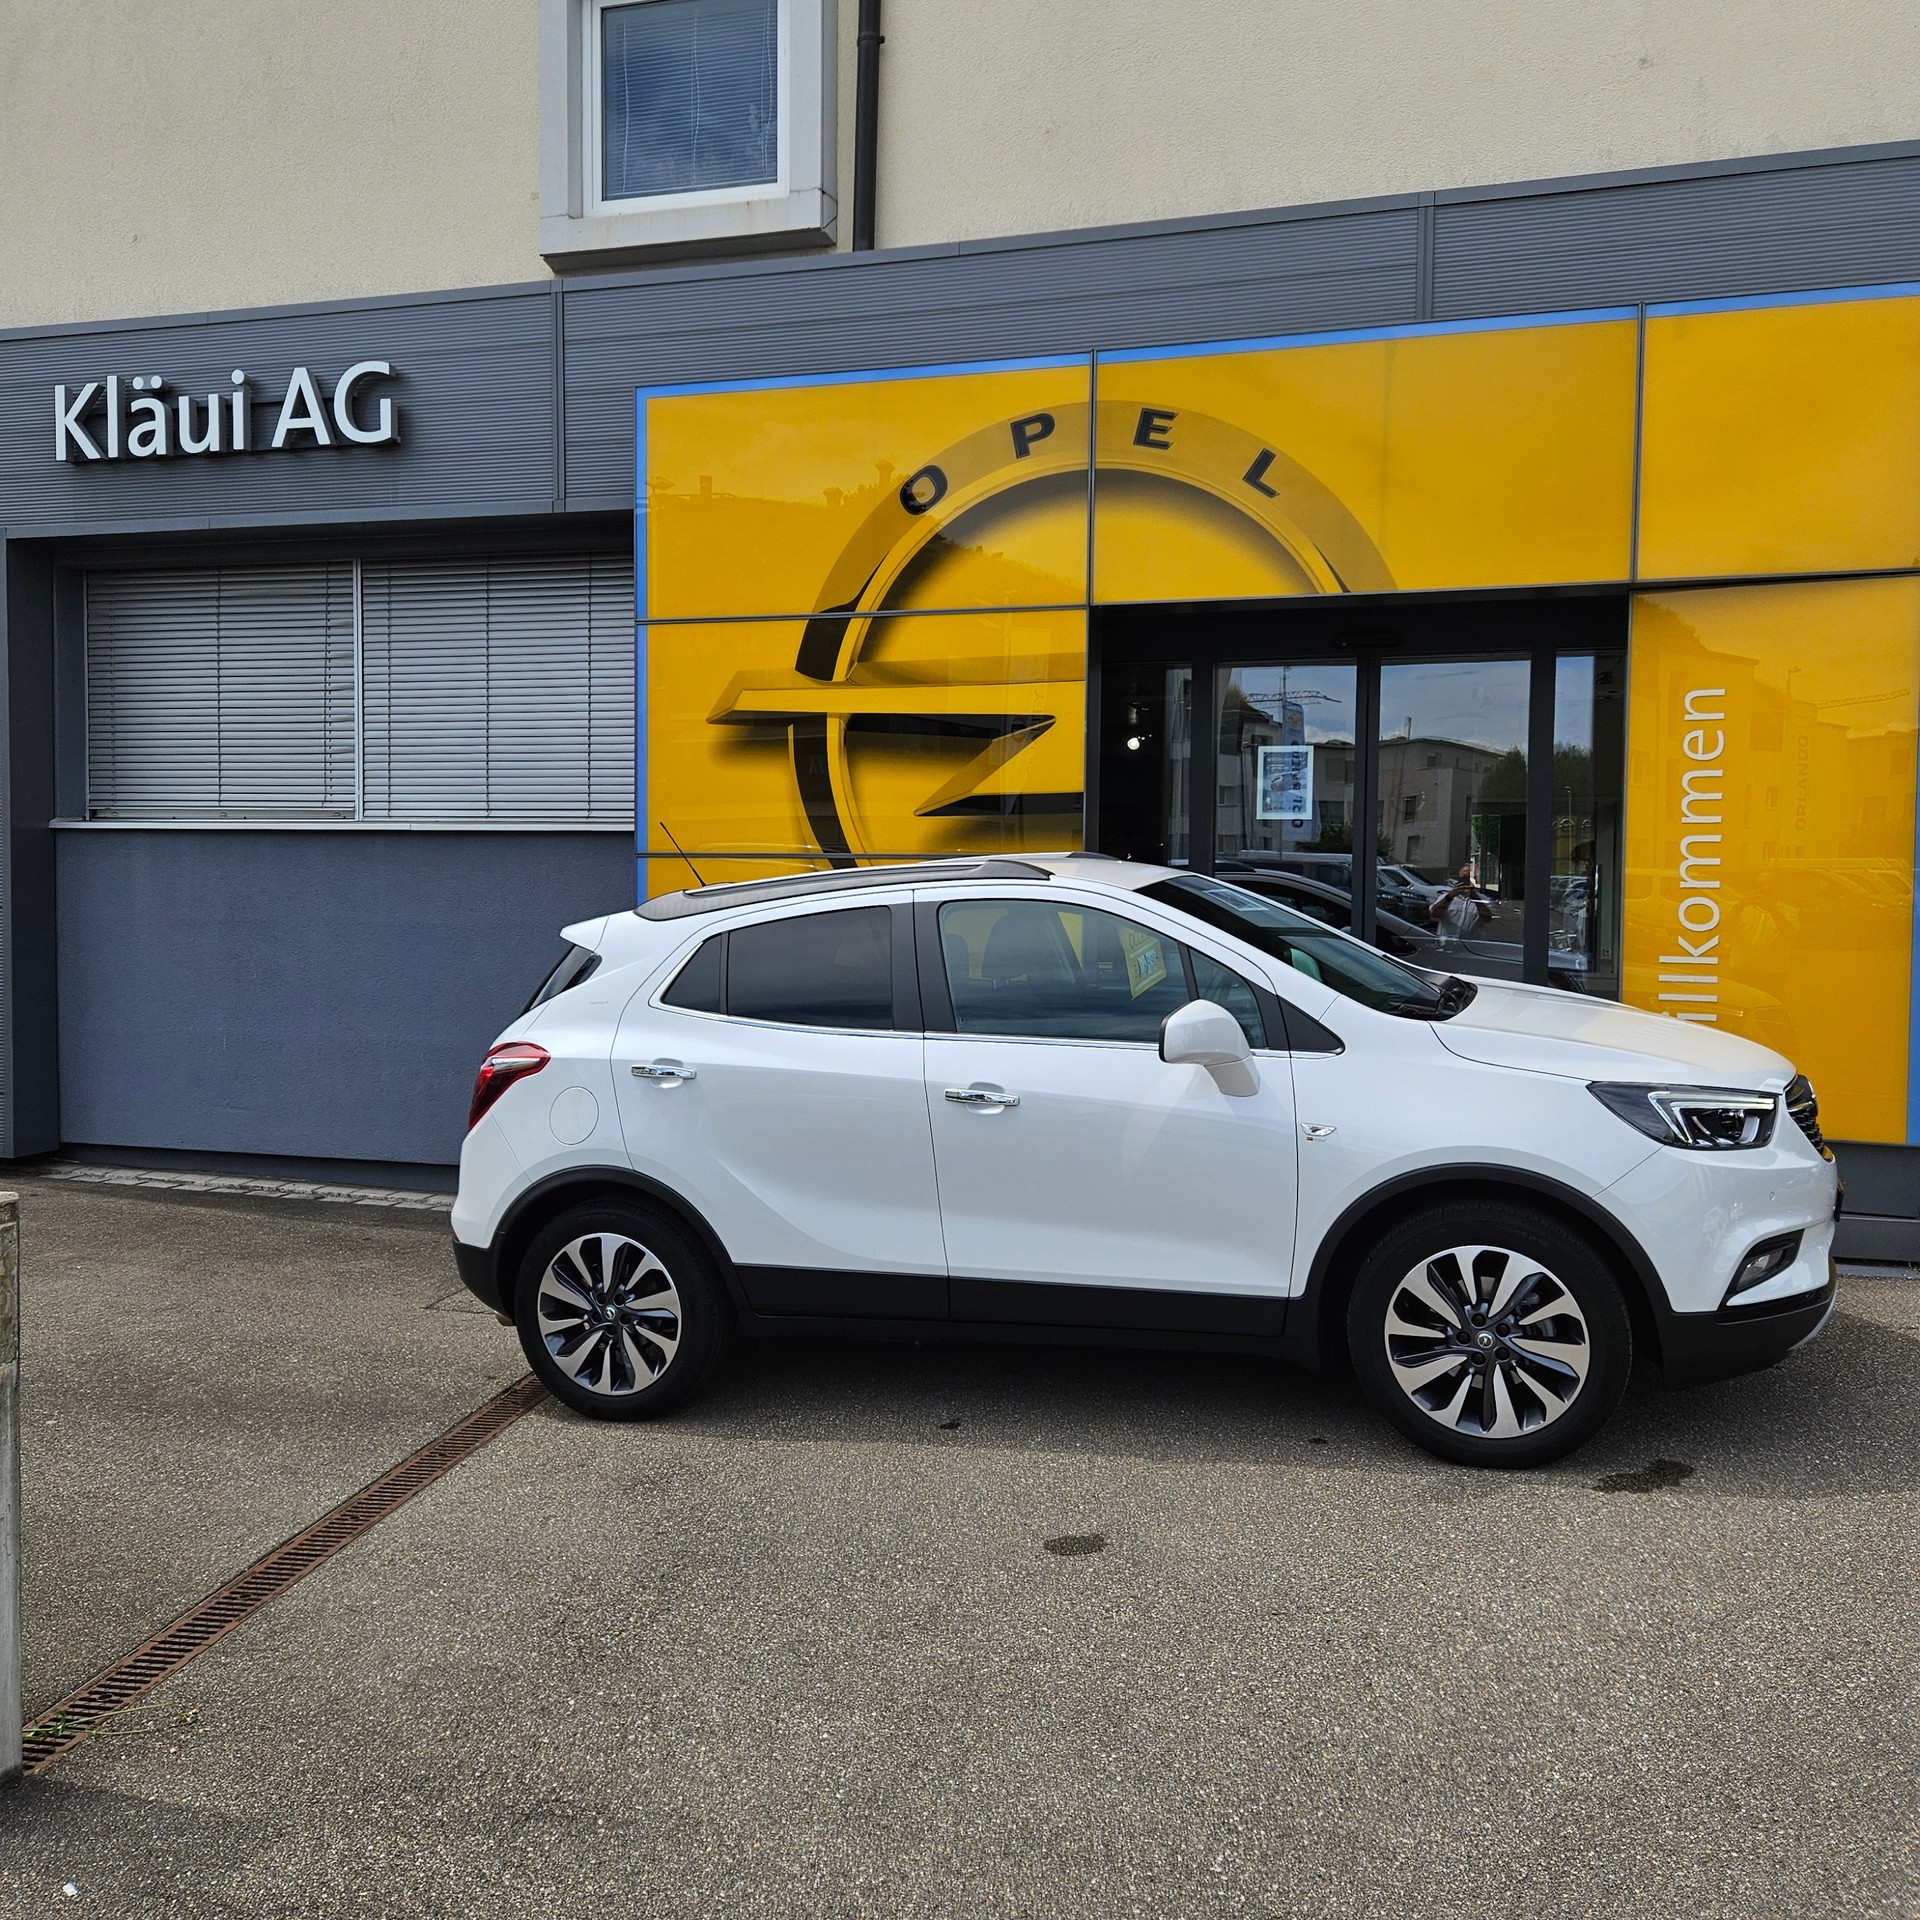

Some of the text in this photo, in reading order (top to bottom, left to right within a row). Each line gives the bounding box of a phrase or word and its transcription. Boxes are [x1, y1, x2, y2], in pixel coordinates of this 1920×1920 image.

[54, 360, 394, 462] Kläui AG
[900, 407, 1281, 516] OPEL
[1795, 734, 1809, 831] ORLANDO
[1658, 687, 1726, 1022] illkommen
